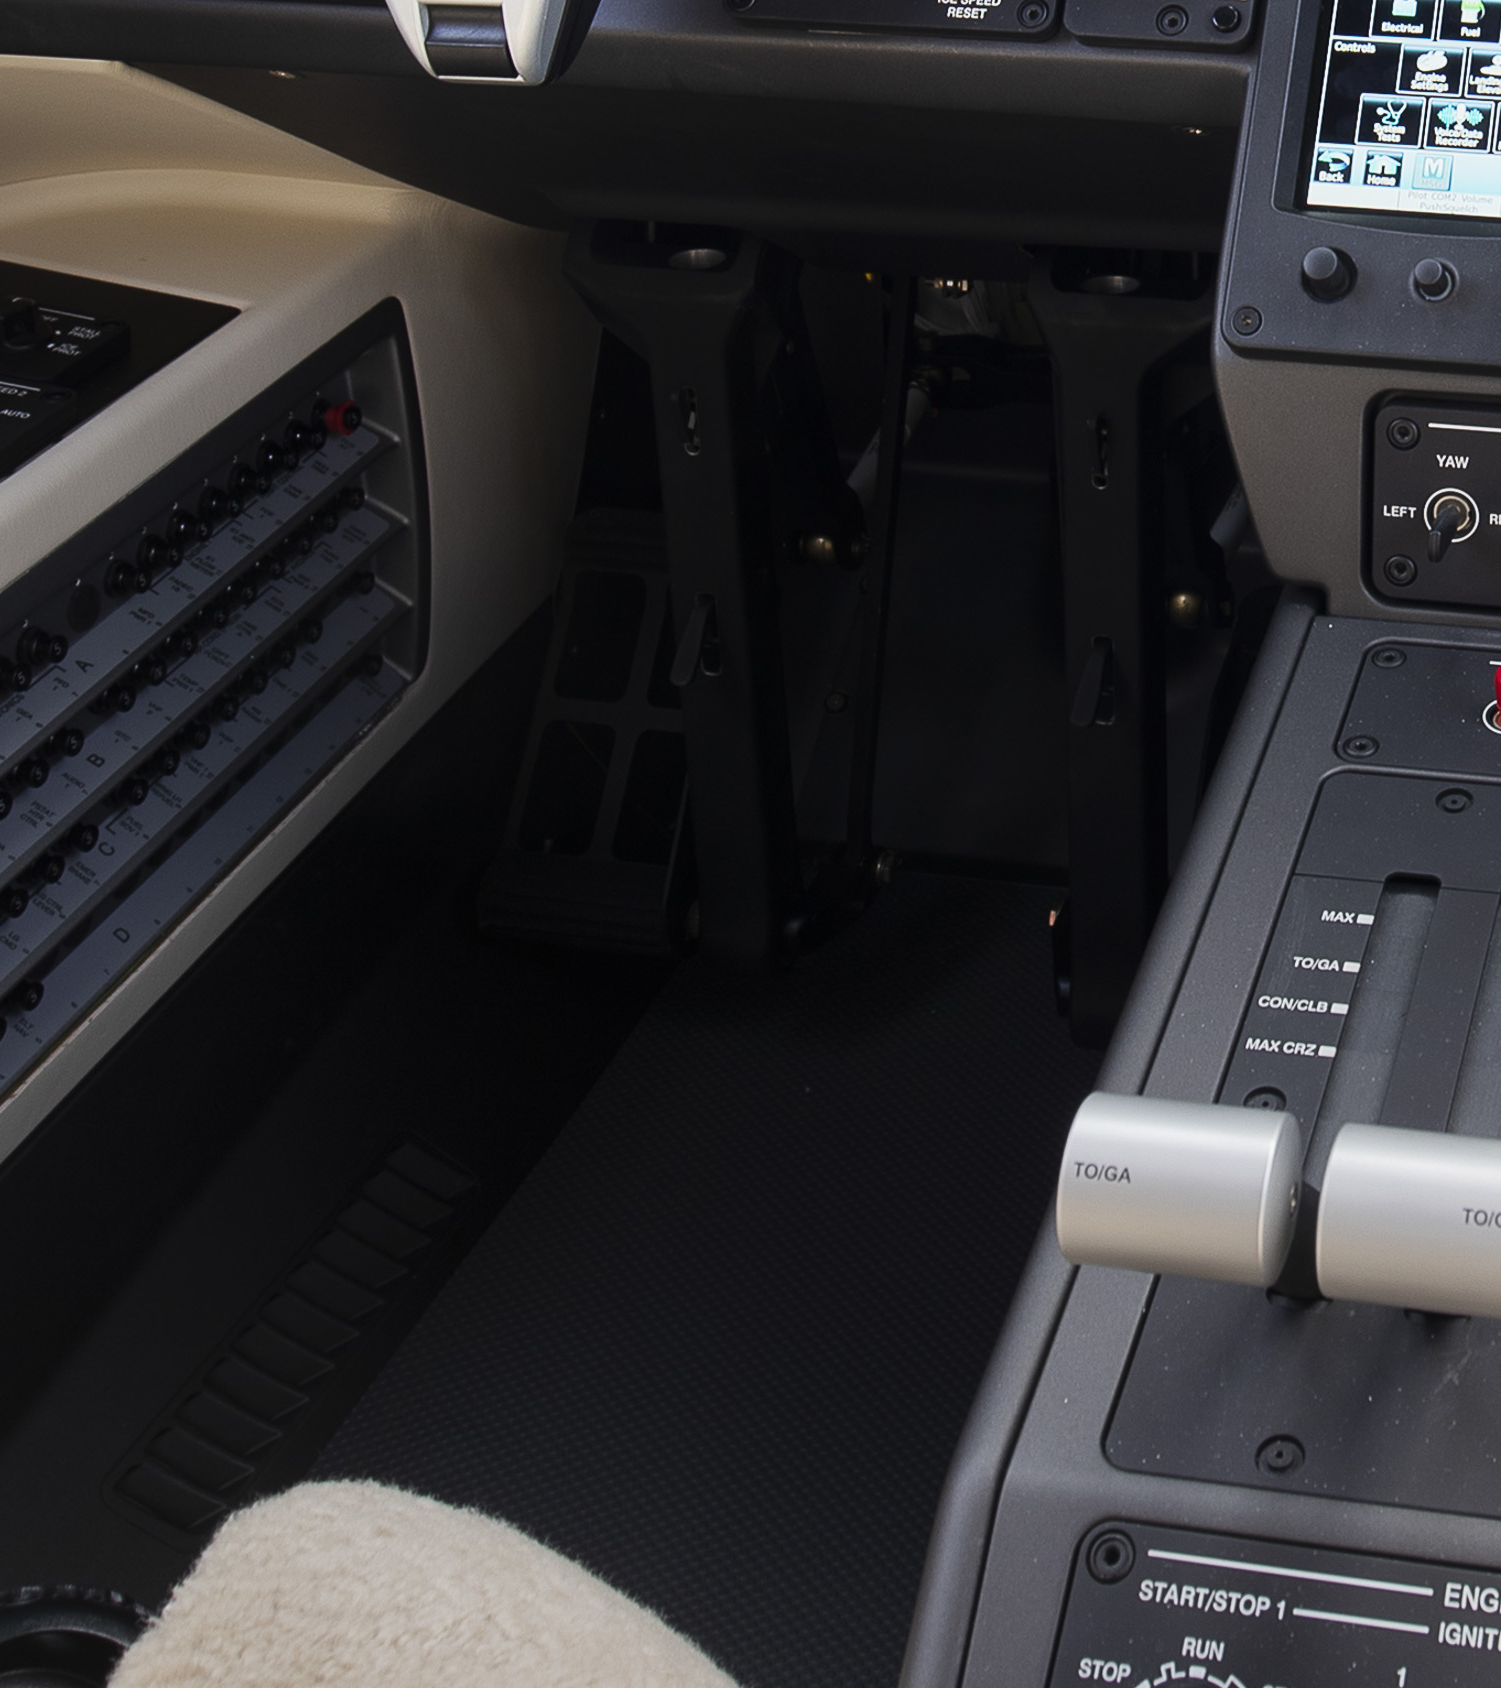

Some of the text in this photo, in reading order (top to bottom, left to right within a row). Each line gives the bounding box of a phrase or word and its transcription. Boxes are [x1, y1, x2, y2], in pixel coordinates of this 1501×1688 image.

[1258, 996, 1328, 1013] CON/CLB
[1074, 1162, 1131, 1185] TO/GA
[1139, 1579, 1287, 1620] START/STOP 1
[1181, 1637, 1224, 1661] RUN
